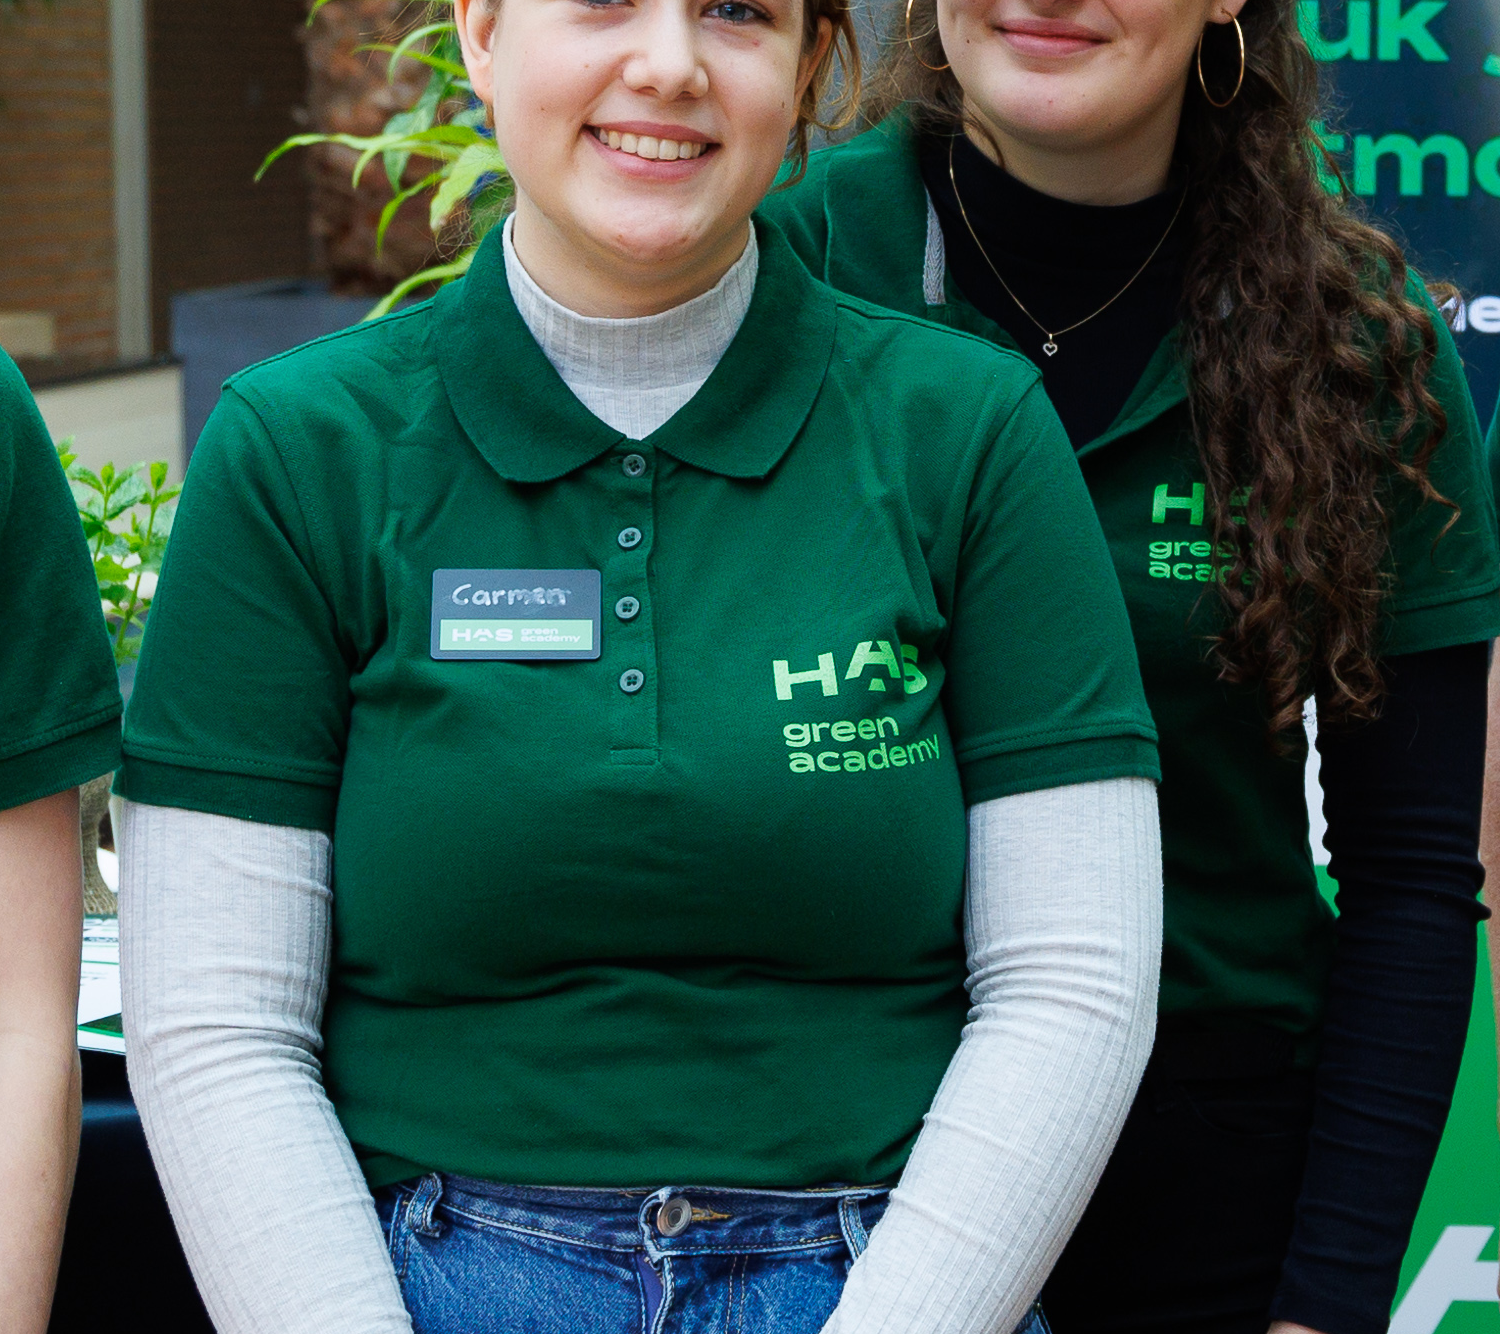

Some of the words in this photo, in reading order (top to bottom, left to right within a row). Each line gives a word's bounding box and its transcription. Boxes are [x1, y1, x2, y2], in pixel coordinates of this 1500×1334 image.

[451, 628, 514, 644] HAS
[520, 628, 559, 637] green
[520, 633, 581, 645] academy
[771, 640, 928, 701] HAS
[782, 715, 899, 748] green
[788, 732, 941, 773] academy
